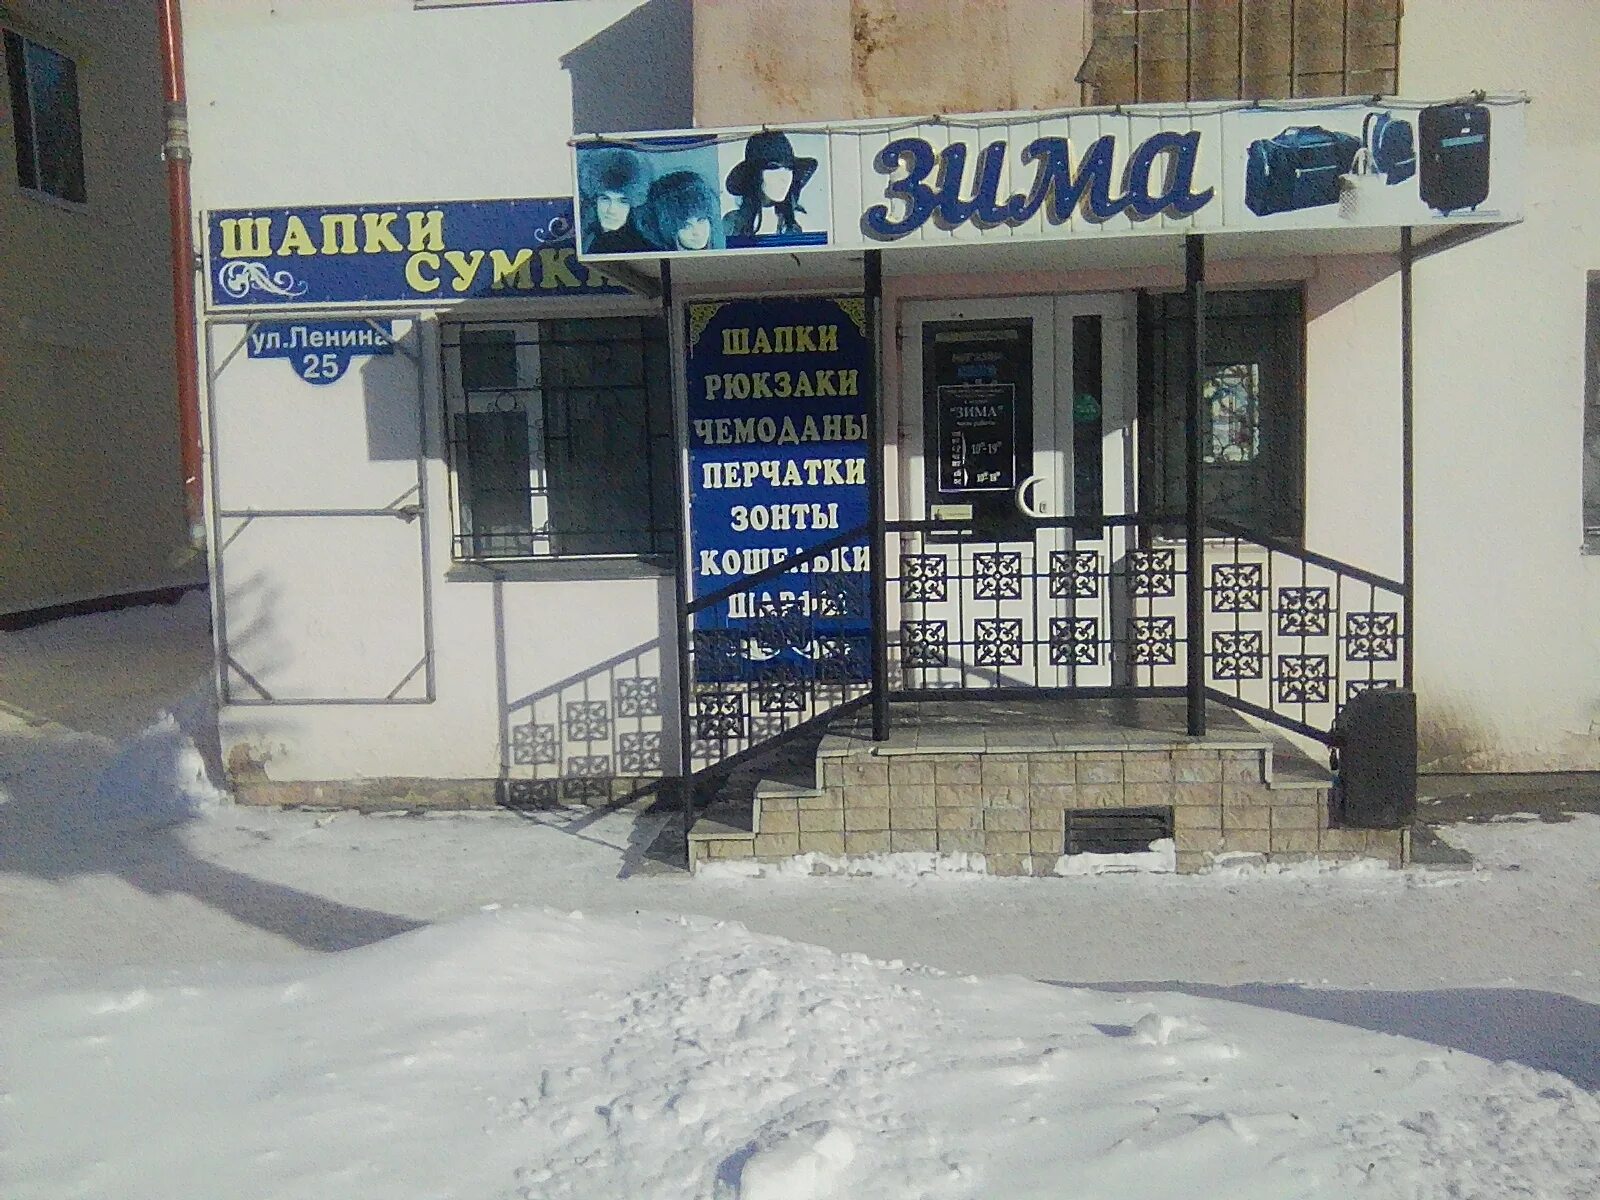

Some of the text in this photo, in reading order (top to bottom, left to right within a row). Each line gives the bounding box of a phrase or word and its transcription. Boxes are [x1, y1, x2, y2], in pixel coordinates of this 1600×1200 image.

[220, 210, 446, 258] ШАПКИ
[721, 325, 839, 355] ШАПКИ
[302, 353, 339, 379] 25
[704, 369, 859, 400] РЮКЗАКИ
[693, 413, 868, 445] ЧЕМОДАНЫ
[702, 458, 866, 488] ПЕРЧАТКИ
[731, 503, 839, 531] ЗОНТЫ
